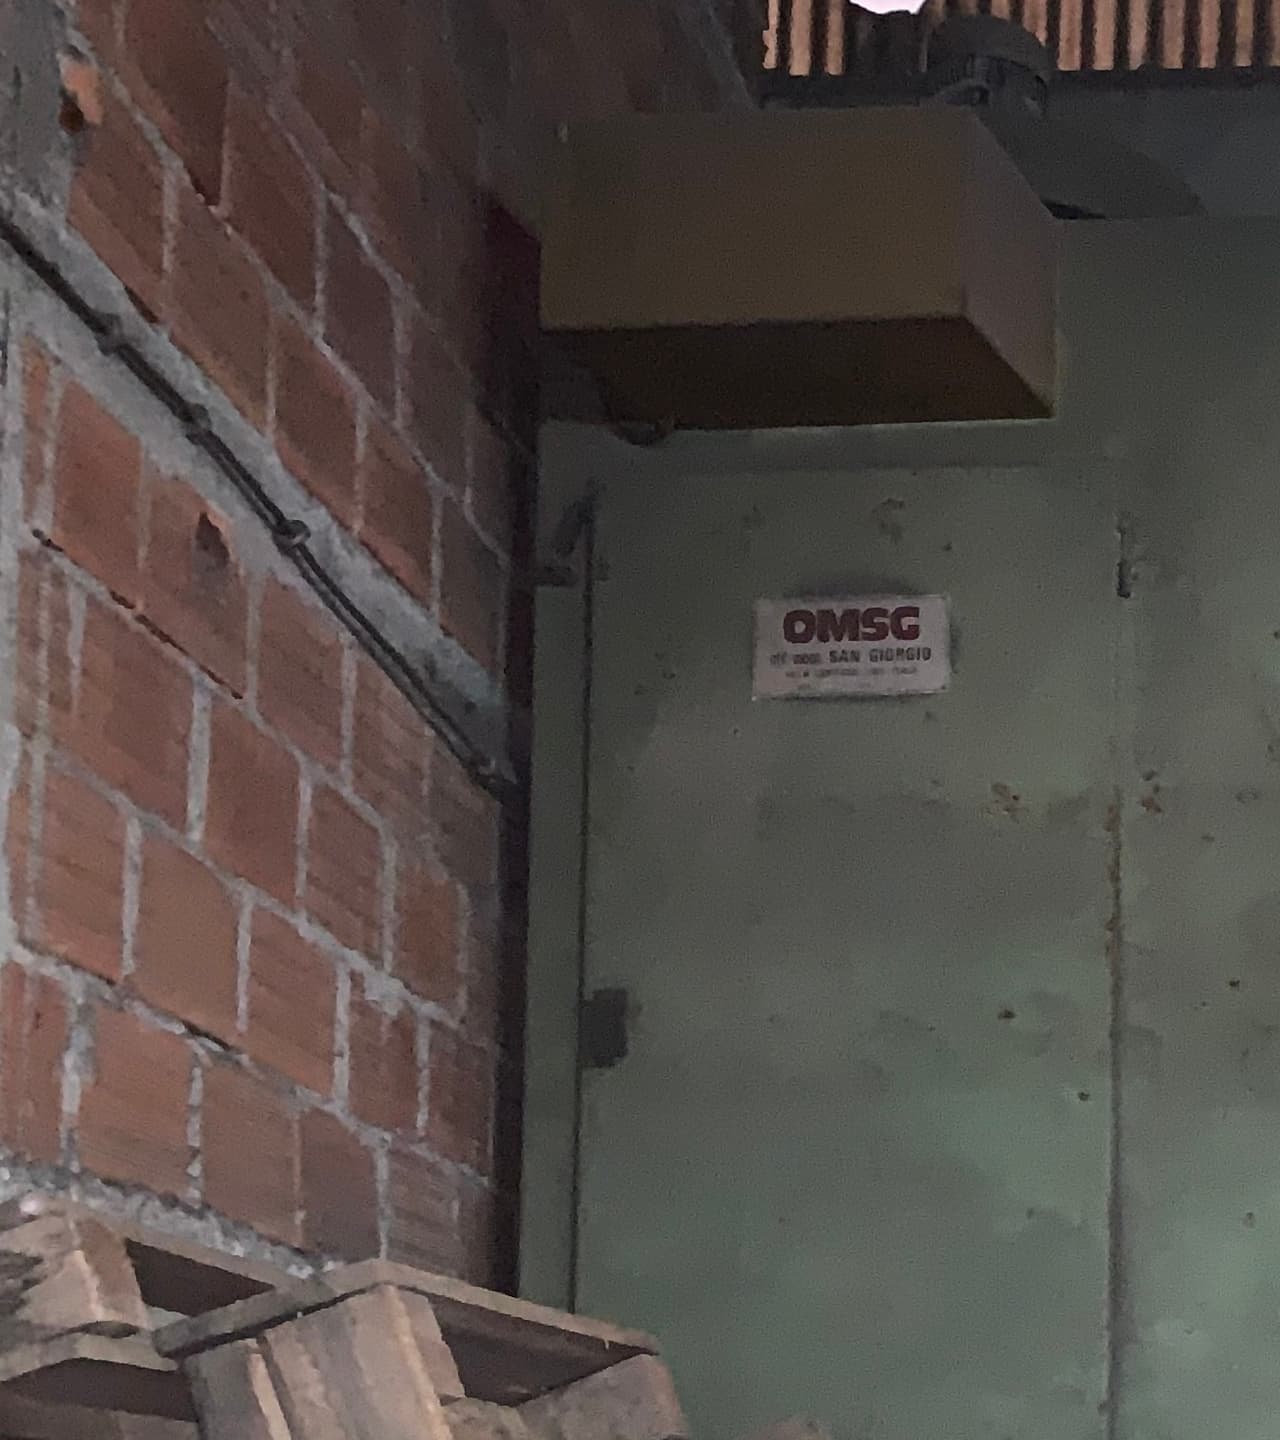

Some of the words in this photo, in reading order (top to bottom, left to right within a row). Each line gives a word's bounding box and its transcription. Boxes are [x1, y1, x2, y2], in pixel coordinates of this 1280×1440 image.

[783, 606, 920, 644] OMSG
[829, 650, 860, 663] SAN
[869, 647, 931, 662] GIORGIO
